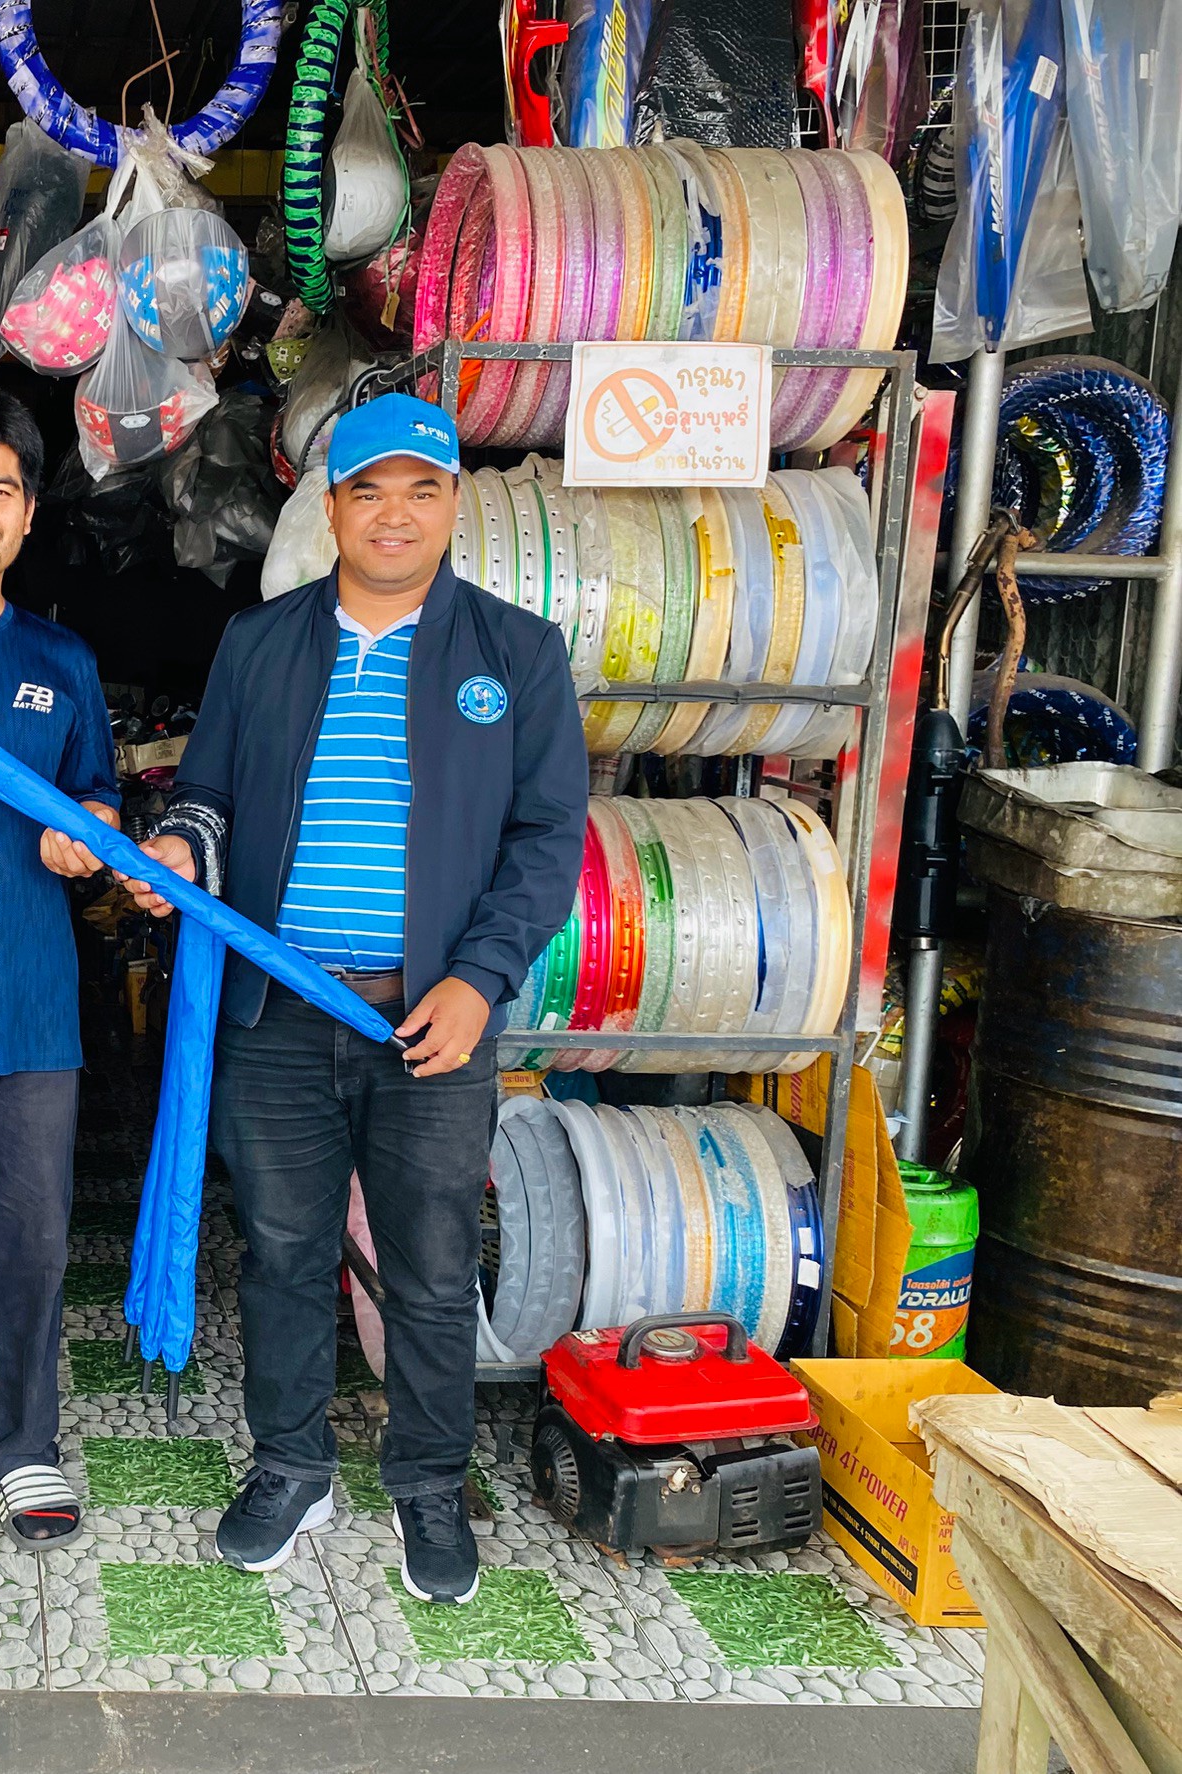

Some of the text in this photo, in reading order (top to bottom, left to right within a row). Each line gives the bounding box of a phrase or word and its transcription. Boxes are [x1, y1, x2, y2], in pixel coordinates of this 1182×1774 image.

[676, 366, 746, 397] กรุณา
[652, 395, 749, 435] งดสูบบุหรี่
[12, 701, 52, 714] BATTERY
[15, 682, 54, 707] FB
[898, 1284, 972, 1307] YDRAULI
[839, 1450, 860, 1477] 4T
[858, 1465, 909, 1523] POWER
